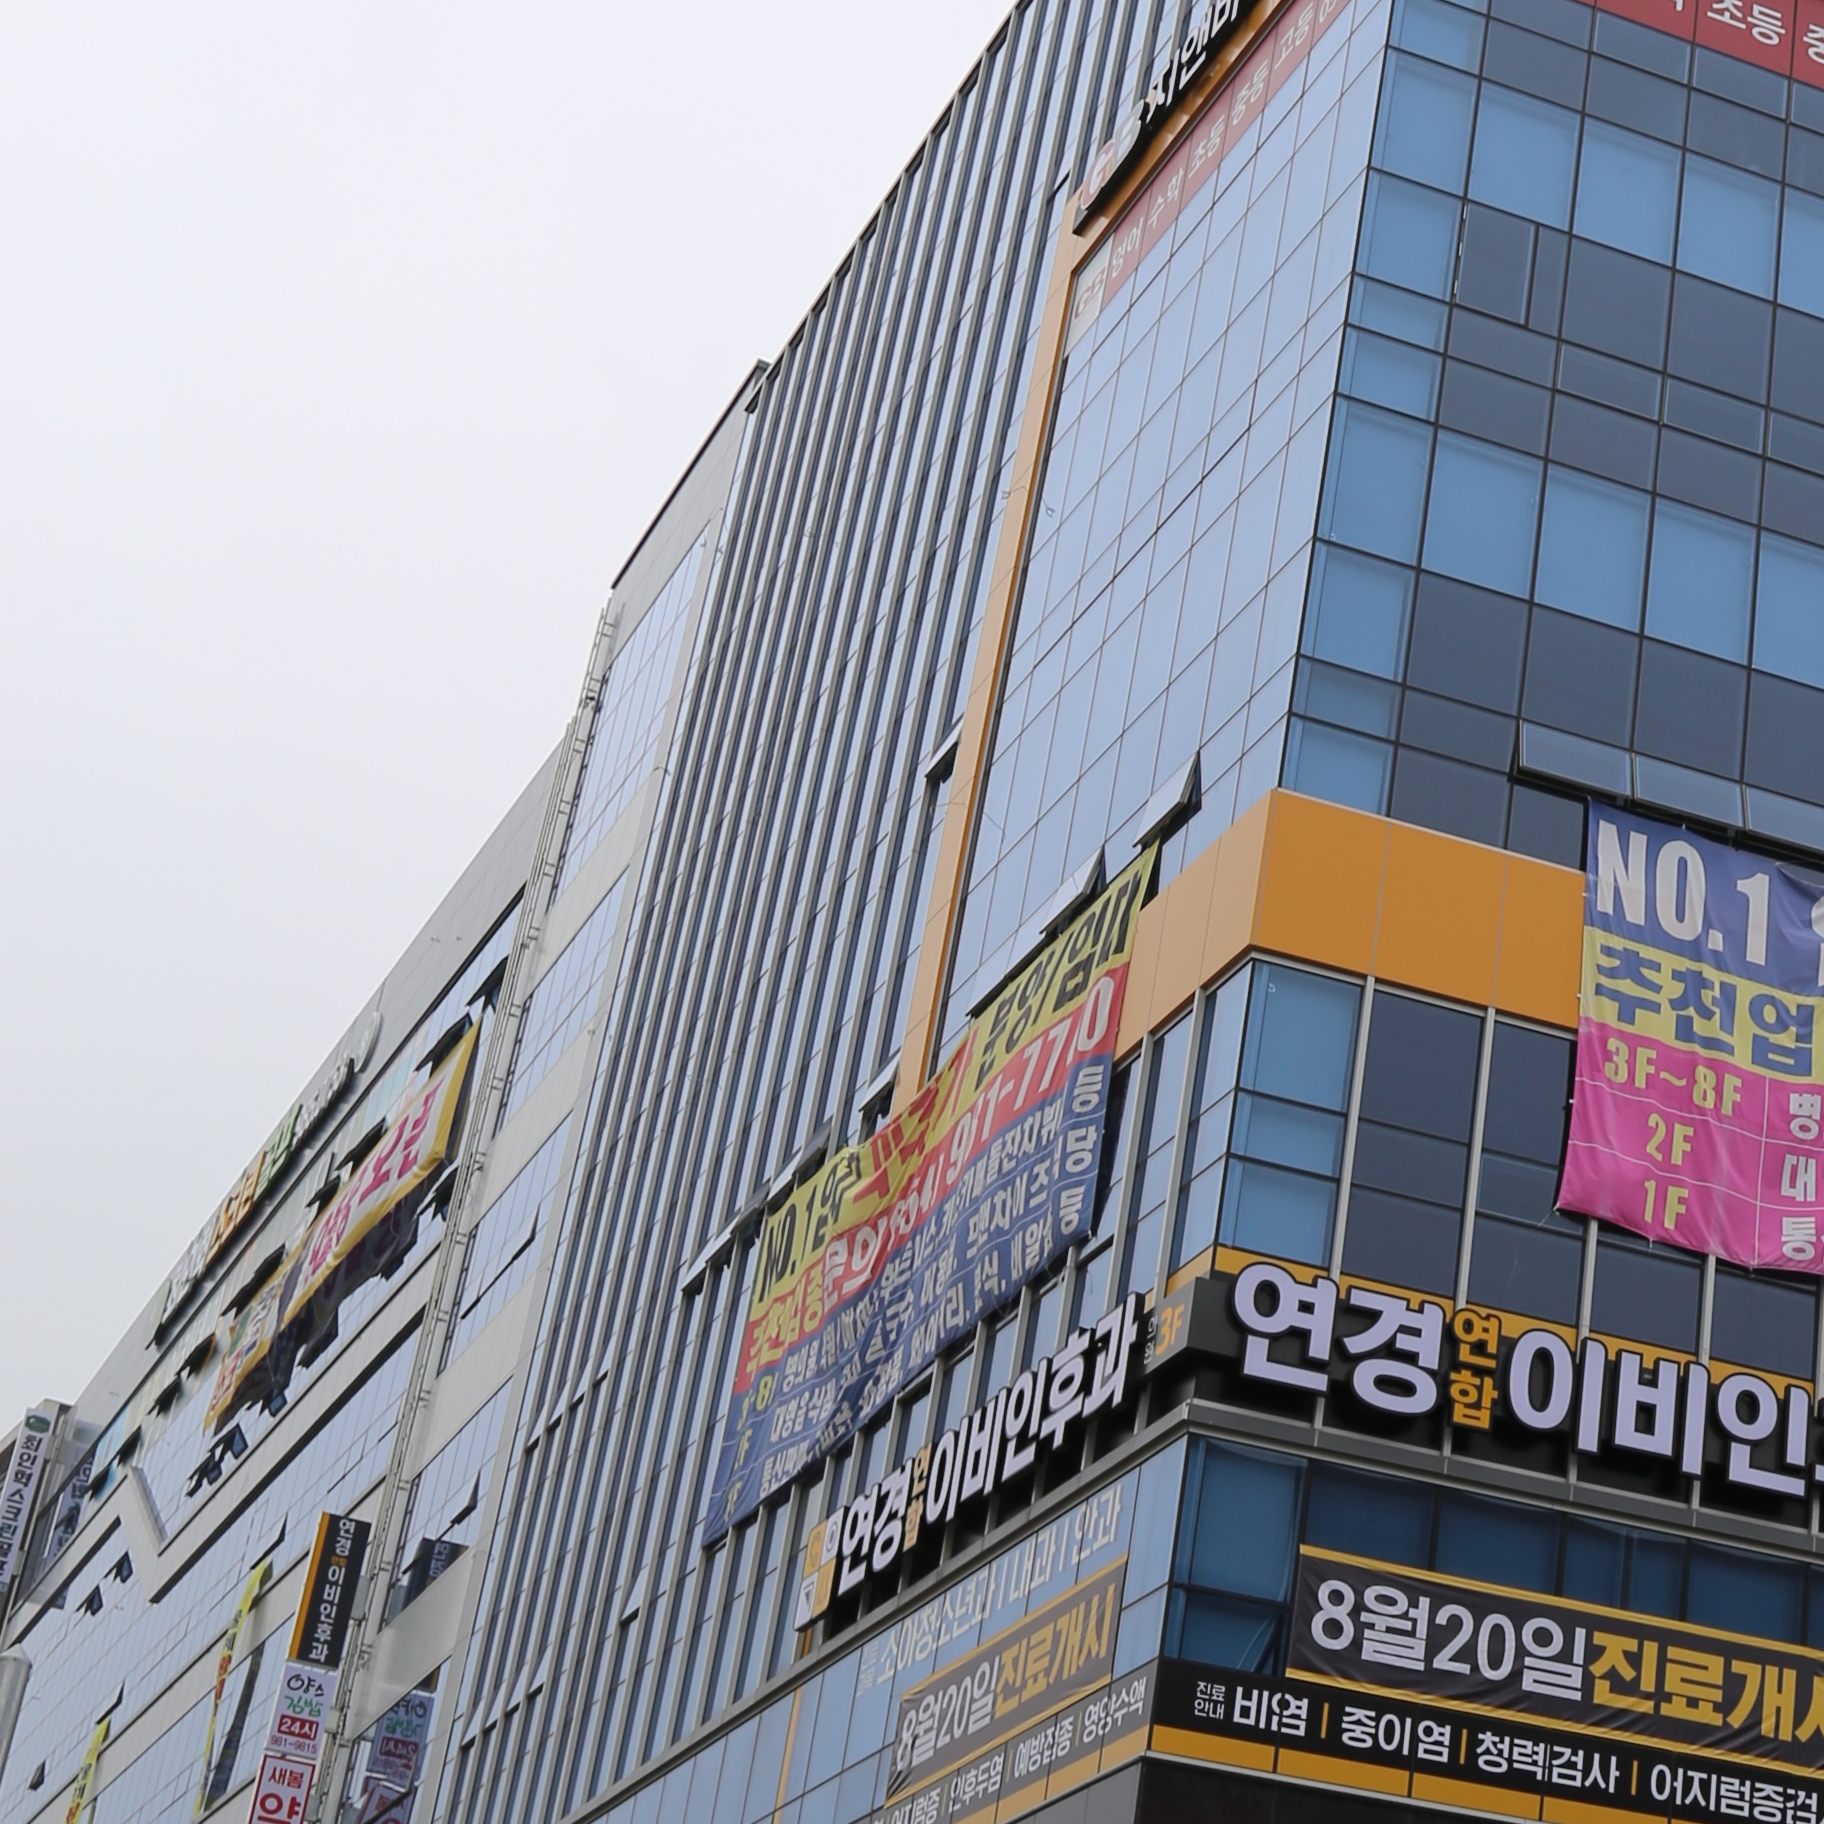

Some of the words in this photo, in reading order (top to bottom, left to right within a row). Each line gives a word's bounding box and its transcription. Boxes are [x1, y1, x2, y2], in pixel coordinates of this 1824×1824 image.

[1275, 1, 1315, 72] 고등
[1595, 818, 1771, 966] NO.1
[1071, 1064, 1104, 1113] 등
[1604, 1038, 1742, 1117] 3F~8F
[1646, 1113, 1694, 1167] 2F
[1059, 1184, 1086, 1235] 등
[1643, 1180, 1689, 1231] 1F
[1231, 1261, 1448, 1417] 연경
[1449, 1307, 1502, 1432] 연합
[836, 1467, 910, 1597] 연경
[926, 1292, 1139, 1525] 이비인후과
[1156, 1301, 1186, 1356] 3F
[338, 1518, 356, 1557] 연경
[309, 1565, 343, 1664] 이비인후과
[877, 1567, 996, 1685] 소아청소년과
[1009, 1525, 1056, 1603] 내과
[1071, 1482, 1122, 1566] 안과
[1309, 1578, 1587, 1702] 8월20일
[279, 1716, 319, 1740] 24시
[284, 1694, 324, 1717] 김밥
[1193, 1698, 1226, 1721] 안내
[270, 1735, 318, 1754] 981-9815
[948, 1752, 1004, 1814] 인후두염
[1013, 1715, 1074, 1779] 예방접종
[1082, 1677, 1146, 1744] 영양수액
[1195, 1680, 1226, 1701] 진료
[1232, 1687, 1308, 1737] 비염
[1340, 1704, 1452, 1764] 중이염
[1476, 1730, 1621, 1794] 청력검사
[267, 1765, 304, 1788] 새봄
